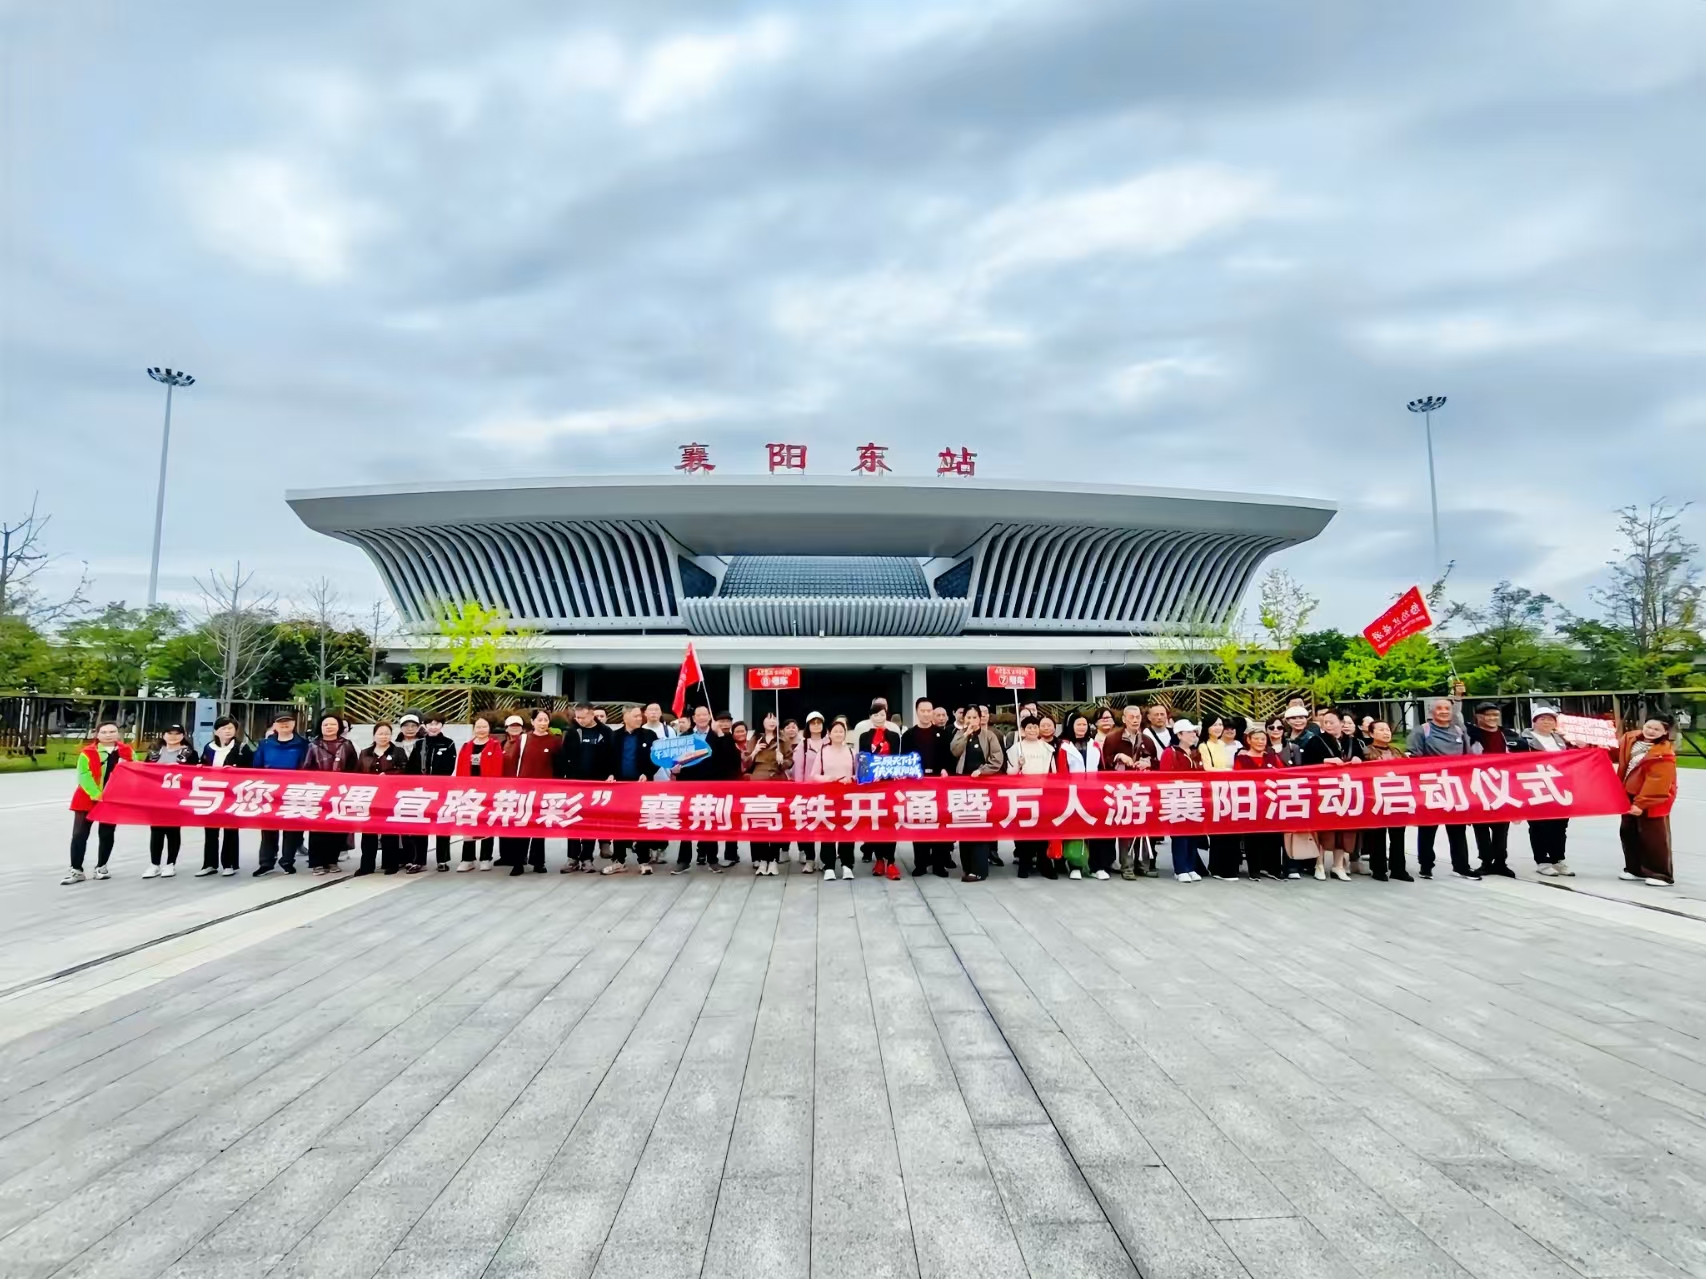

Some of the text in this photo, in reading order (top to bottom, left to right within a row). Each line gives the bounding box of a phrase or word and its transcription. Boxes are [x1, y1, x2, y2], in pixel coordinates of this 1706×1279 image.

[674, 442, 978, 477] 襄阳东站
[638, 764, 1573, 832] 襄荆高铁开通暨万人游襄阳活动启动仪式
